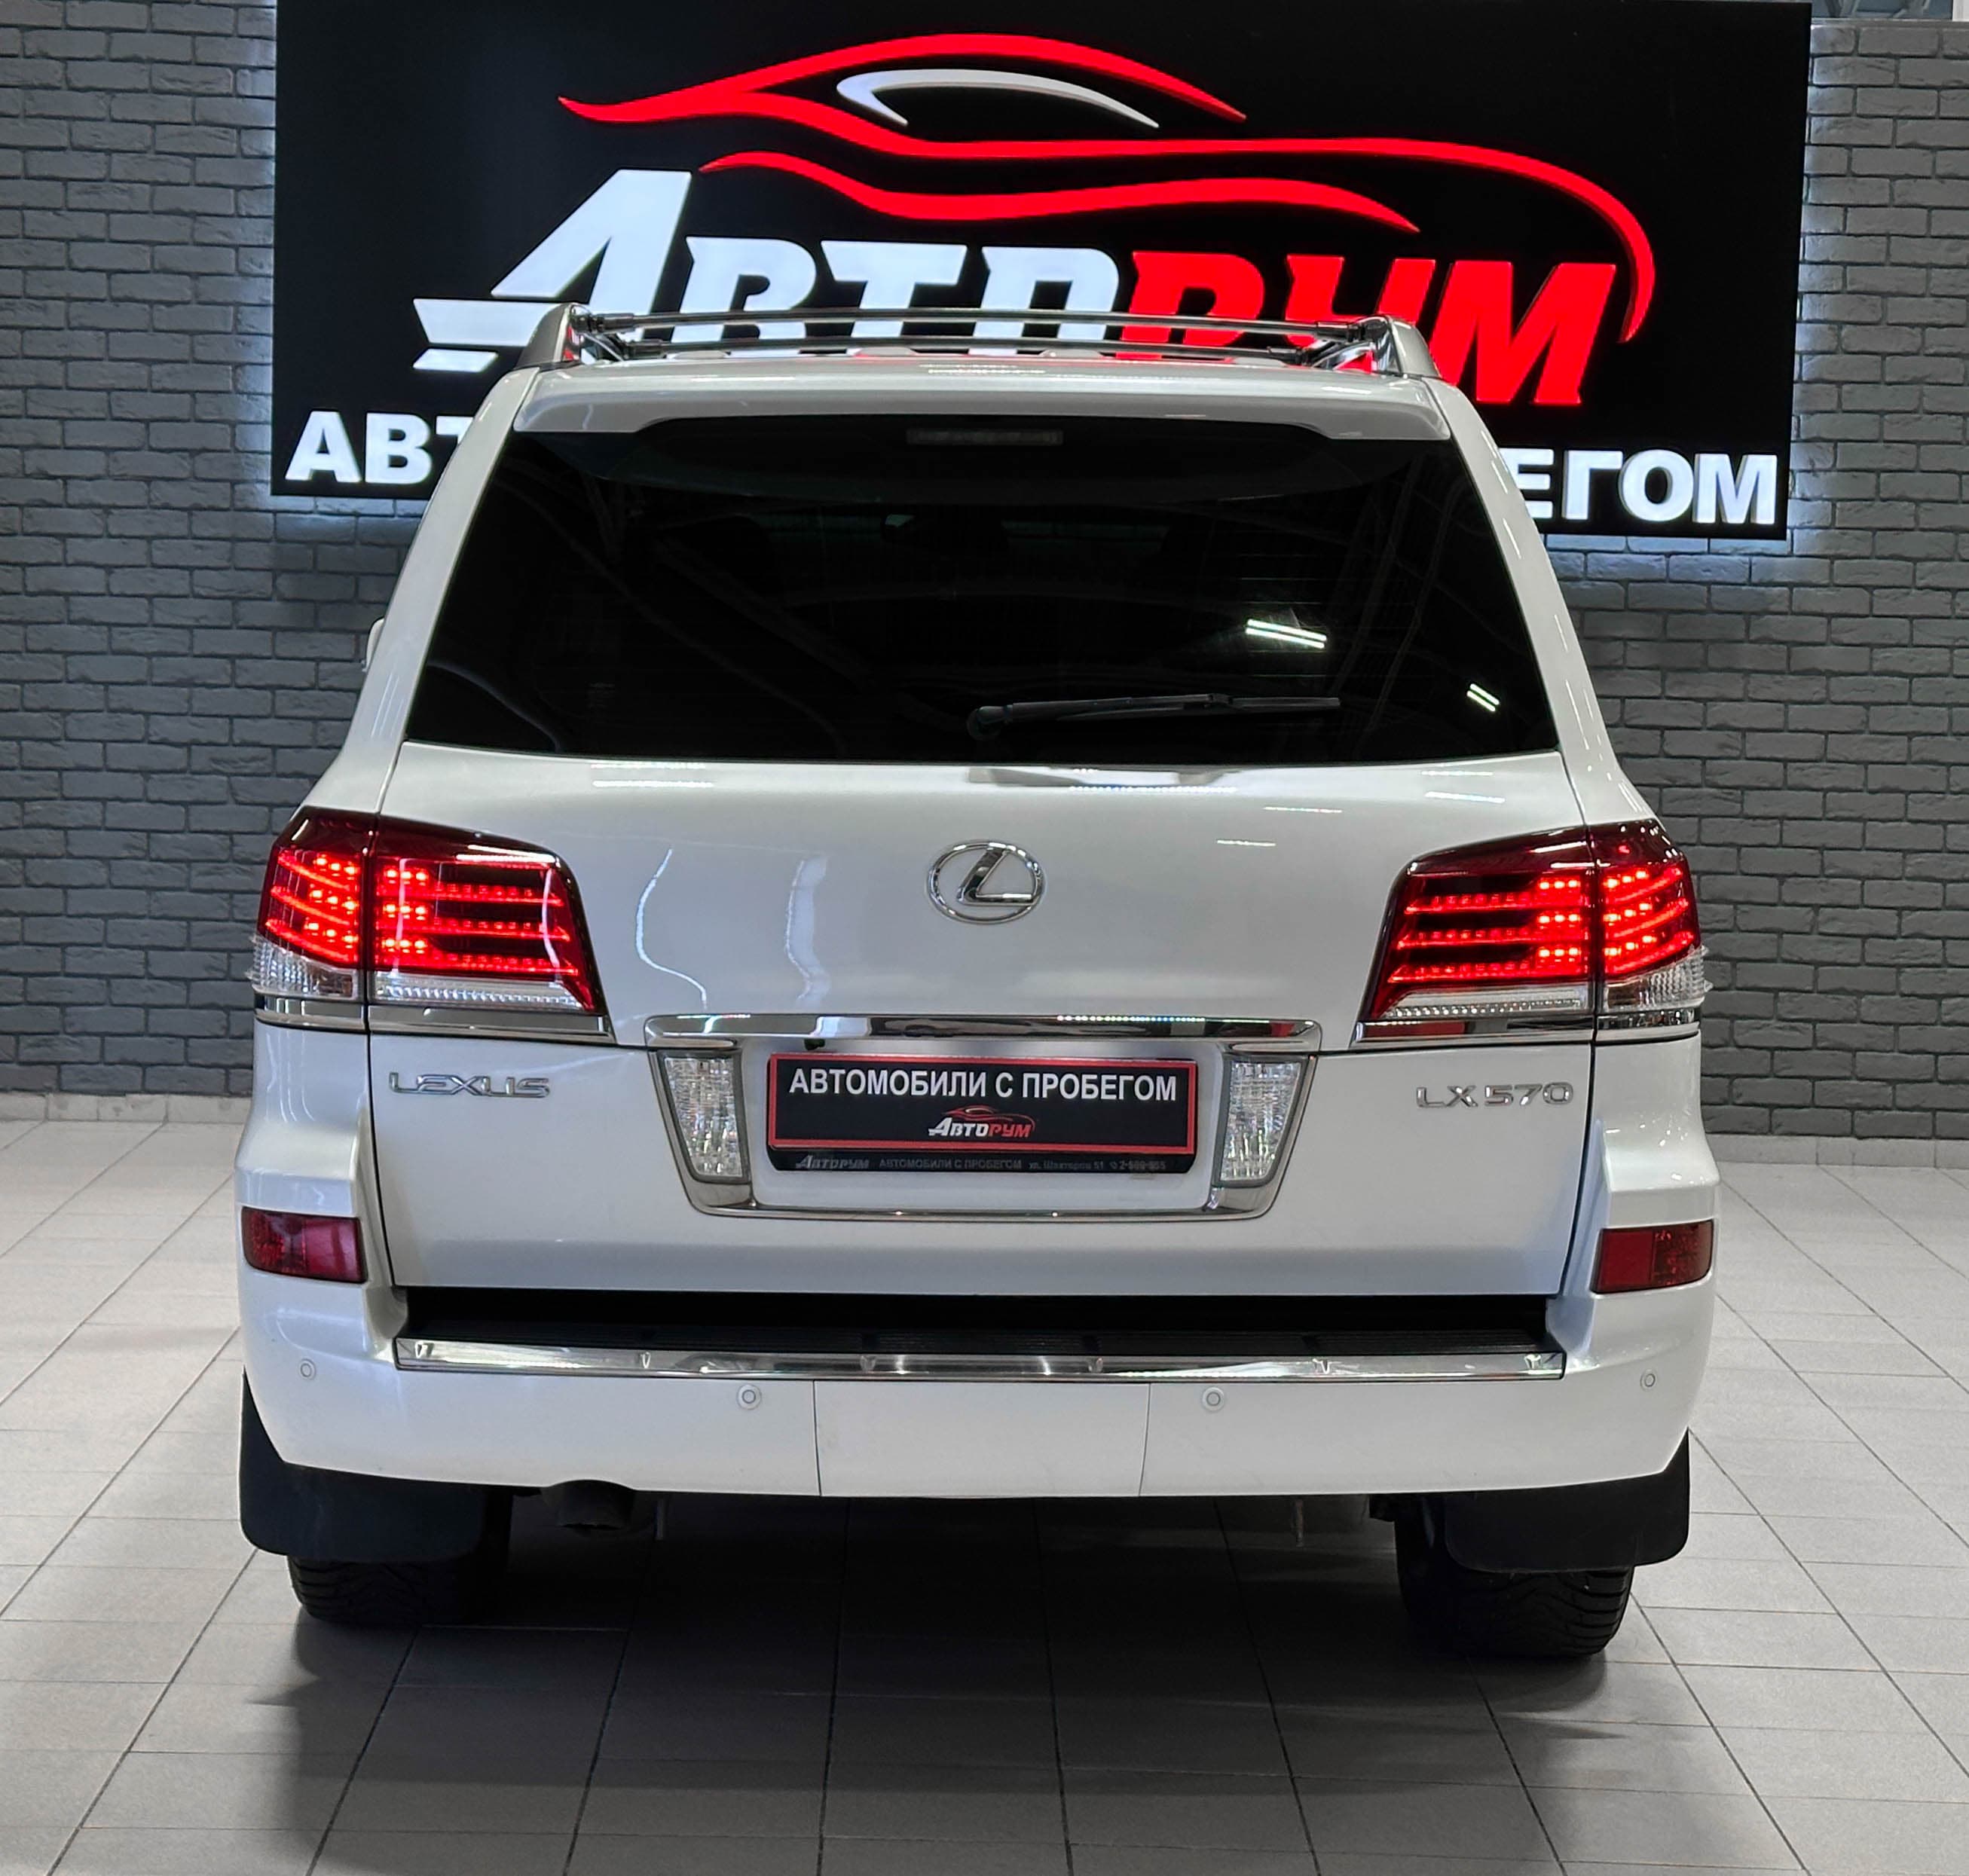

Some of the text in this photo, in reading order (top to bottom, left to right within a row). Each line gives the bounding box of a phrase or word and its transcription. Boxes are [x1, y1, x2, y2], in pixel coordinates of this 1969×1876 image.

[389, 1071, 551, 1098] LEXUS
[789, 1068, 1177, 1101] АВТОМОБИЛИ С ПРОБЕГОМ
[1416, 1082, 1574, 1108] LX 570
[879, 1158, 952, 1169] АВТОМОБИЛИ
[954, 1160, 962, 1169] С
[965, 1160, 1023, 1169] ПРОБЕГОМ
